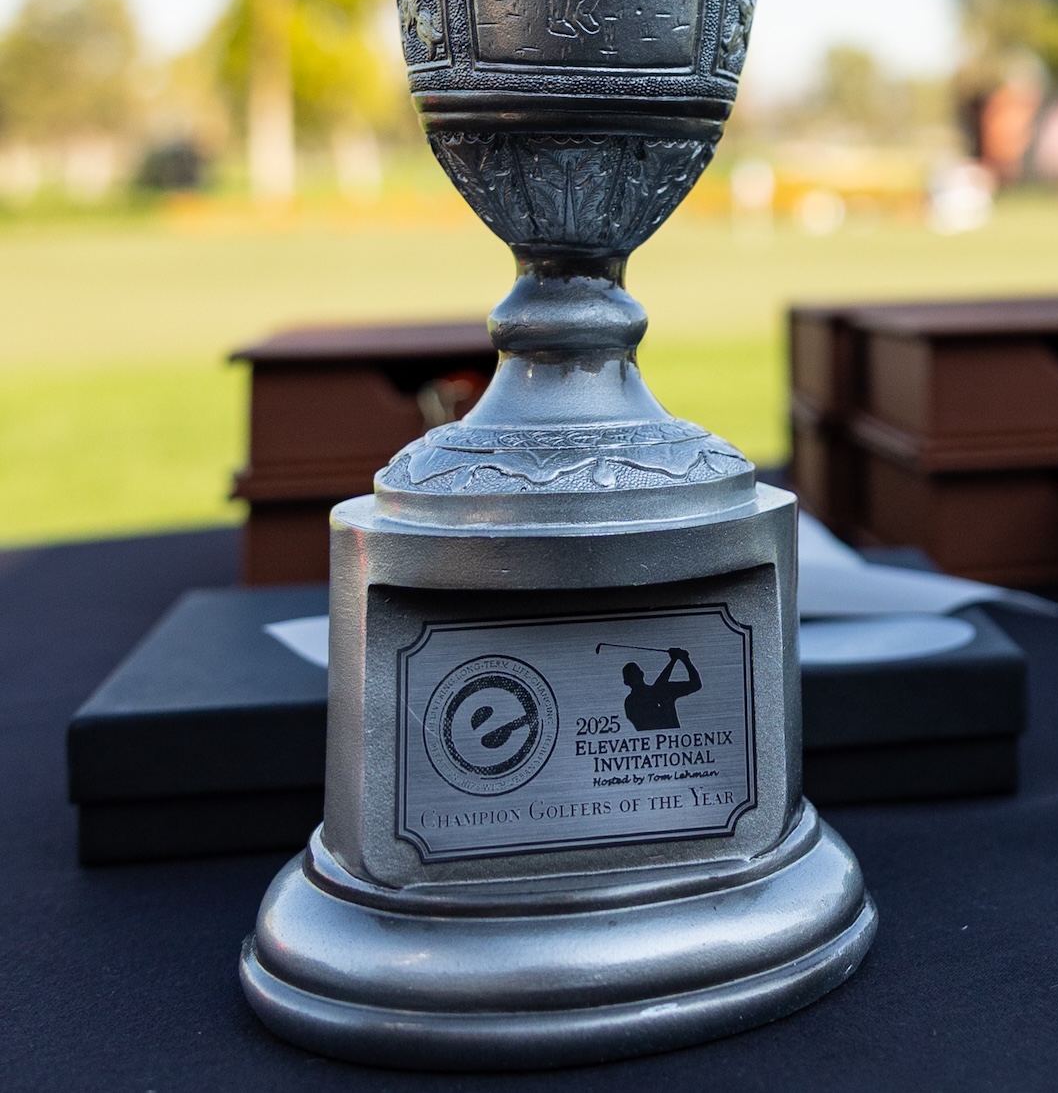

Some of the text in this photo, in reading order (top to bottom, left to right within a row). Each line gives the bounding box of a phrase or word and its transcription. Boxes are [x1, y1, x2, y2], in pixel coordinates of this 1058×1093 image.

[576, 715, 621, 736] 2025
[575, 731, 733, 756] ELEVATE PHOENIX
[593, 750, 716, 773] INVITATIONAL
[593, 770, 720, 787] Hosted by Tom Lehman
[420, 787, 735, 829] CHAMPION GOLFERS OF THE YEAR
